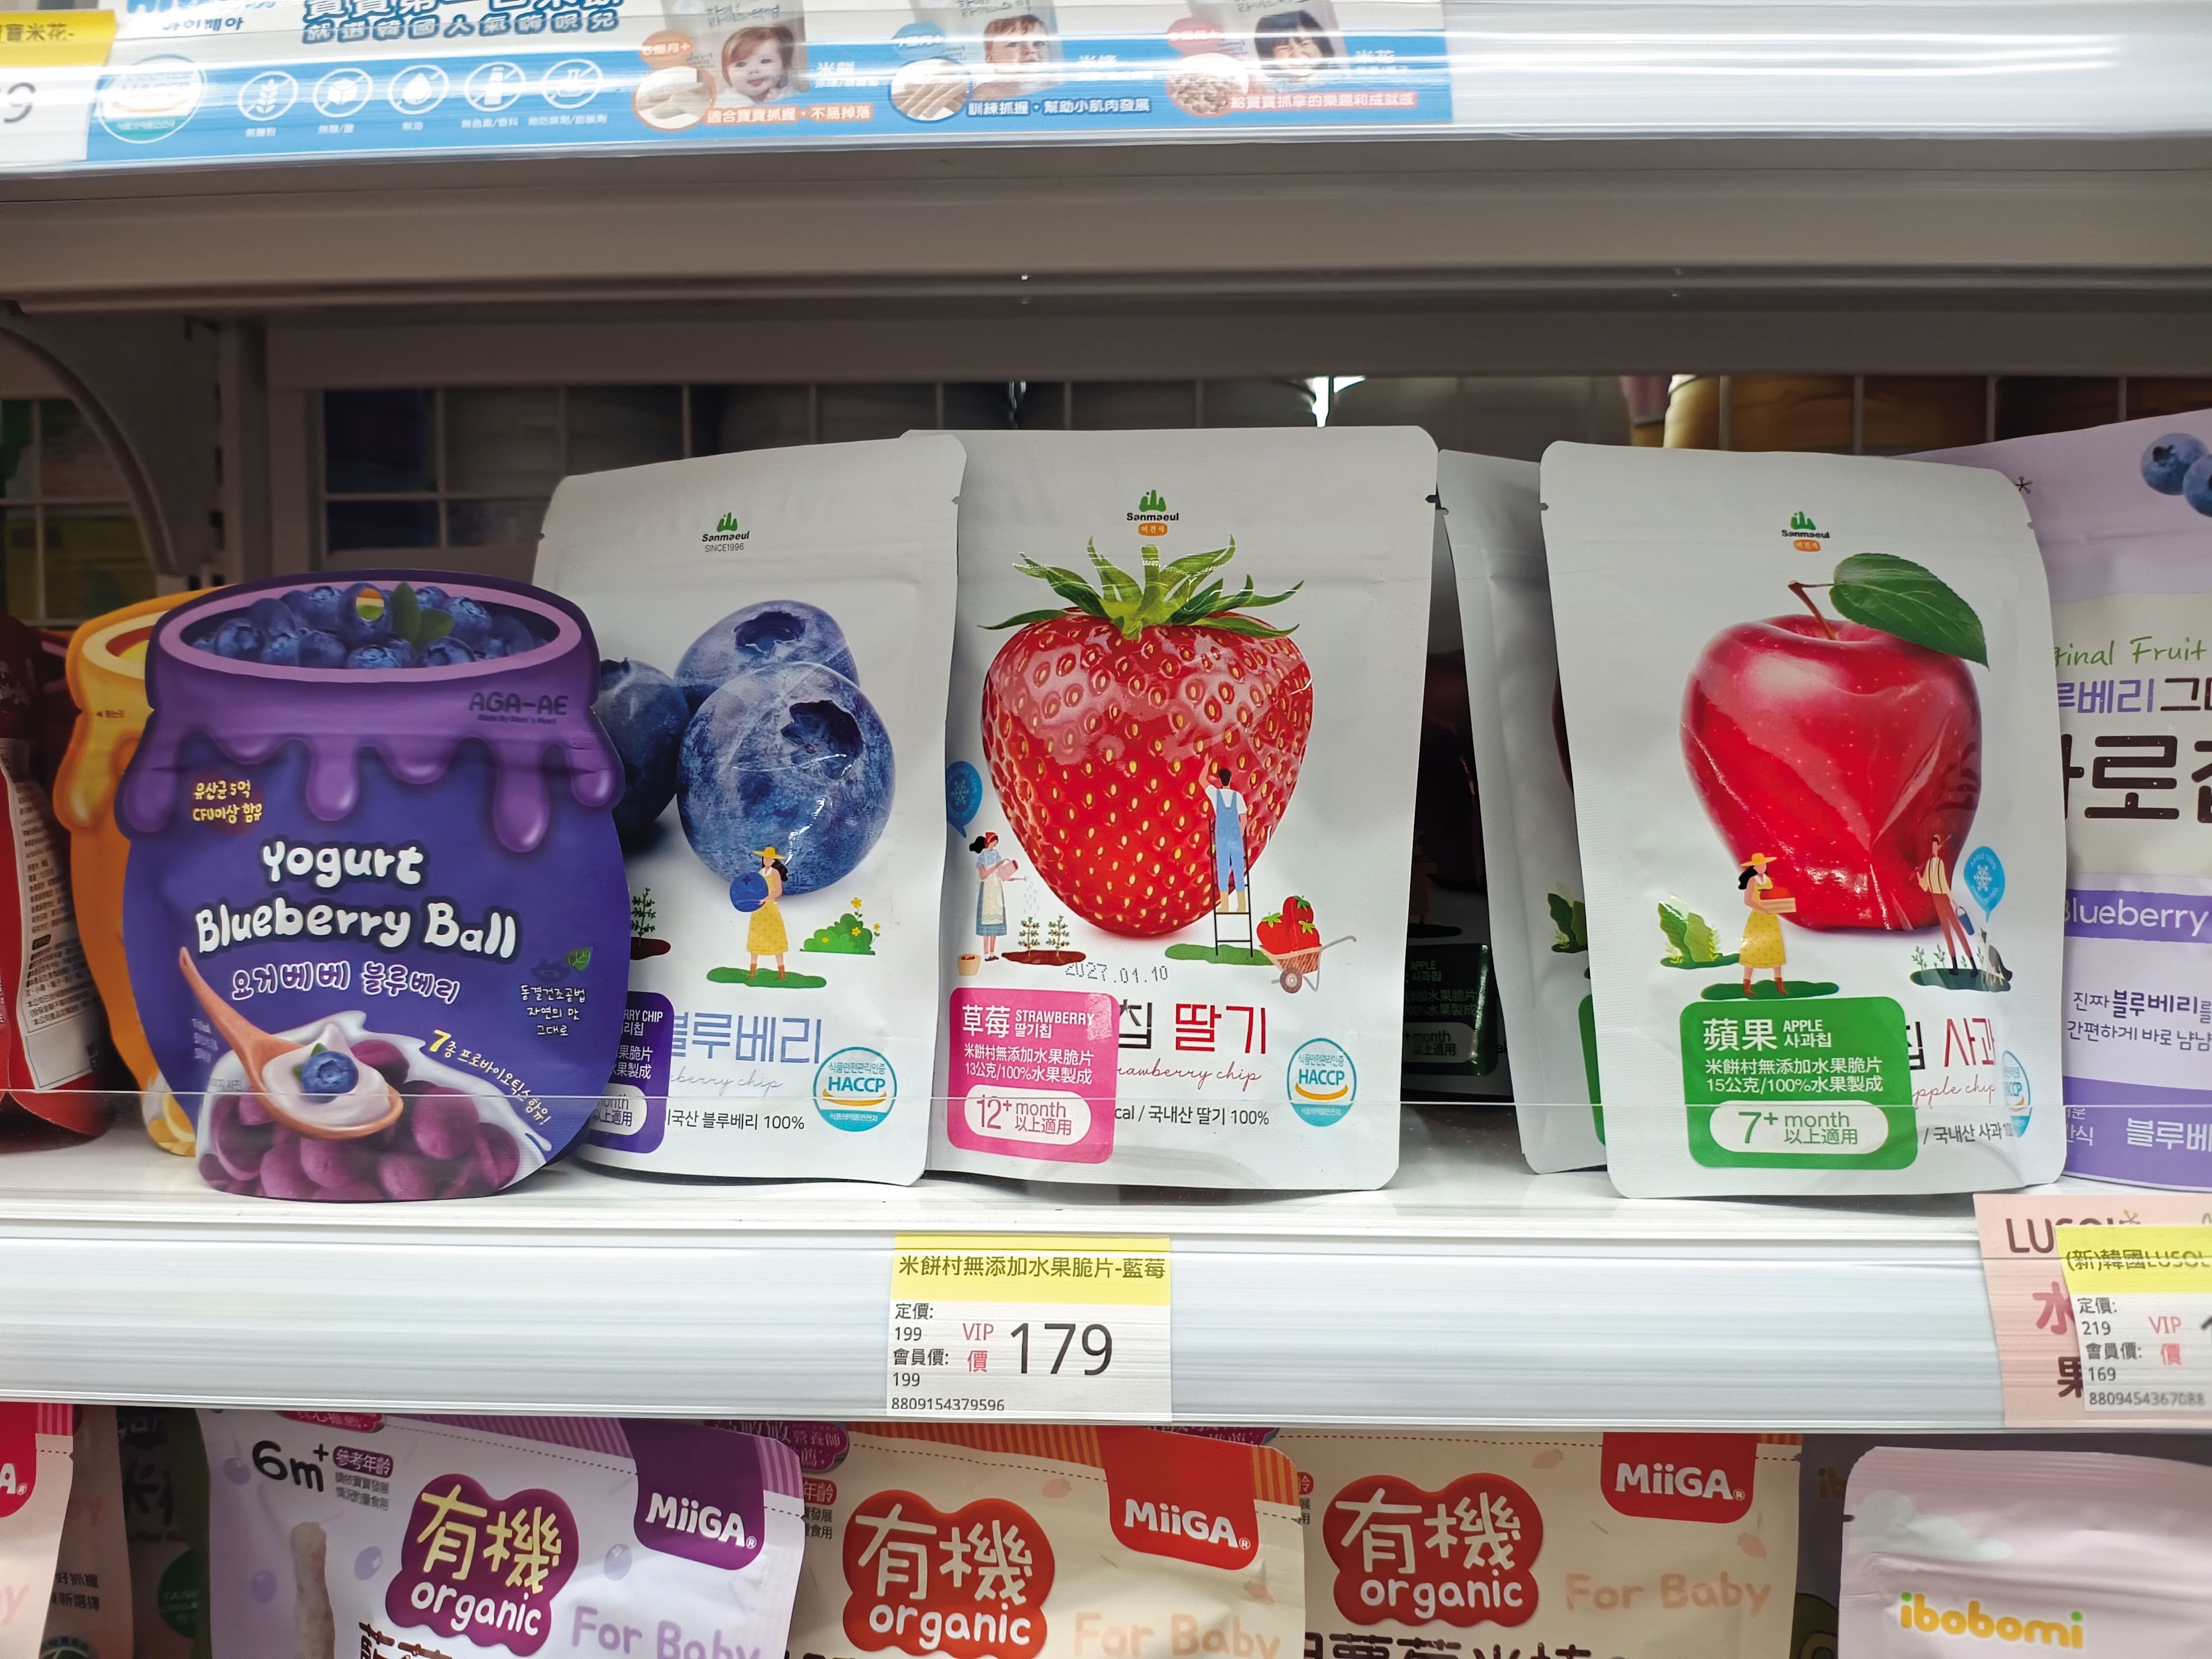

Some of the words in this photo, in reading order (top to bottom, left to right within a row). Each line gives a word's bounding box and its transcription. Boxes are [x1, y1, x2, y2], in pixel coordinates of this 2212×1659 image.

[0, 23, 74, 42] 寶米花-
[1126, 512, 1179, 521] Sanmaeul
[702, 531, 749, 542] Sanmaeul
[1781, 529, 1830, 539] Sanmaeul
[2130, 636, 2207, 664] Fruit
[468, 692, 569, 715] AGA-AE
[195, 780, 228, 801] 유산균
[230, 779, 251, 799] 5억
[193, 804, 240, 824] CFU이상
[242, 802, 263, 823] 함유
[263, 840, 424, 889] Yogurt
[195, 897, 411, 955] Blueberry
[424, 903, 518, 960] Ball
[232, 960, 351, 1001] 요거베베
[361, 960, 460, 1005] 블루베리
[1066, 962, 1168, 983] 2027.01.10
[520, 984, 586, 1003] 동결건조공법
[527, 1006, 562, 1019] 자연의
[567, 1008, 581, 1021] 맛
[642, 1010, 664, 1022] CHIP
[2073, 991, 2109, 1012] 진짜
[2113, 990, 2211, 1024] 블루베리를
[536, 1024, 569, 1036] 그대로
[622, 1021, 645, 1037] 리칩
[961, 1003, 1011, 1039] 草莓
[1015, 1008, 1095, 1026] STRAWBERRY
[1014, 1022, 1053, 1039] 딸기칩
[1175, 1002, 1267, 1055] 딸기
[1703, 1018, 1778, 1052] 蘋果
[1782, 1019, 1823, 1033] APPLE
[1783, 1032, 1832, 1048] 사과칩
[2067, 1020, 2138, 1042] 간편하게
[2142, 1029, 2172, 1046] 바로
[429, 1029, 457, 1058] 7종
[457, 1048, 532, 1101] 프로바이오틱스
[964, 1042, 1095, 1067] 米餅村無添加水果脆片
[965, 1060, 1093, 1086] 13公克/100%水果製成
[1217, 1060, 1262, 1092] chip
[1705, 1056, 1883, 1076] 米餅村無添加水果脆片
[737, 1069, 784, 1098] chip
[828, 1076, 886, 1093] HACCP
[1298, 1069, 1345, 1086] HACCP
[1706, 1075, 1884, 1095] 15公克/100%水果製成
[1911, 1075, 1963, 1110] pple
[1016, 1100, 1066, 1118] month
[1148, 1105, 1194, 1126] 국내산
[1197, 1106, 1226, 1127] 딸기
[1230, 1109, 1270, 1126] 100%
[1785, 1111, 1850, 1128] month
[702, 1112, 758, 1131] 블루베리
[763, 1115, 805, 1131] 100%
[1014, 1116, 1072, 1136] 以上適用
[1783, 1128, 1859, 1146] 以上適用
[1933, 1124, 1975, 1145] 국내산
[1978, 1122, 2002, 1141] 사과
[898, 1255, 1166, 1279] 米餅村無添加水果脆片-藍莓
[895, 1302, 934, 1320] 定價:
[2077, 1297, 2118, 1315] 定價:
[895, 1327, 922, 1342] 199
[962, 1323, 994, 1342] VIP
[2082, 1321, 2111, 1336] 219
[2149, 1316, 2182, 1335] VIP
[893, 1347, 949, 1367] 會員價:
[1010, 1323, 1113, 1376] 179
[2085, 1342, 2142, 1361] 會員價:
[2160, 1343, 2181, 1366] 價
[967, 1350, 988, 1373] 價
[892, 1372, 921, 1388] 199
[2088, 1366, 2117, 1382] 169
[891, 1397, 1005, 1412] 8809154379596
[334, 1447, 392, 1478] 參考年齡
[417, 1483, 563, 1595] 有機
[1335, 1487, 1521, 1575] 有機
[855, 1502, 1033, 1606] 有機
[1360, 1569, 1523, 1620] organic
[1563, 1572, 1644, 1611] For
[1660, 1570, 1772, 1618] Baby
[411, 1581, 543, 1637] organic
[868, 1601, 1032, 1651] organic
[1900, 1591, 2084, 1650] ibobomi
[571, 1605, 643, 1656] For
[657, 1619, 762, 1659] Baby
[1074, 1612, 1155, 1658] For
[1171, 1612, 1282, 1659] Baby
